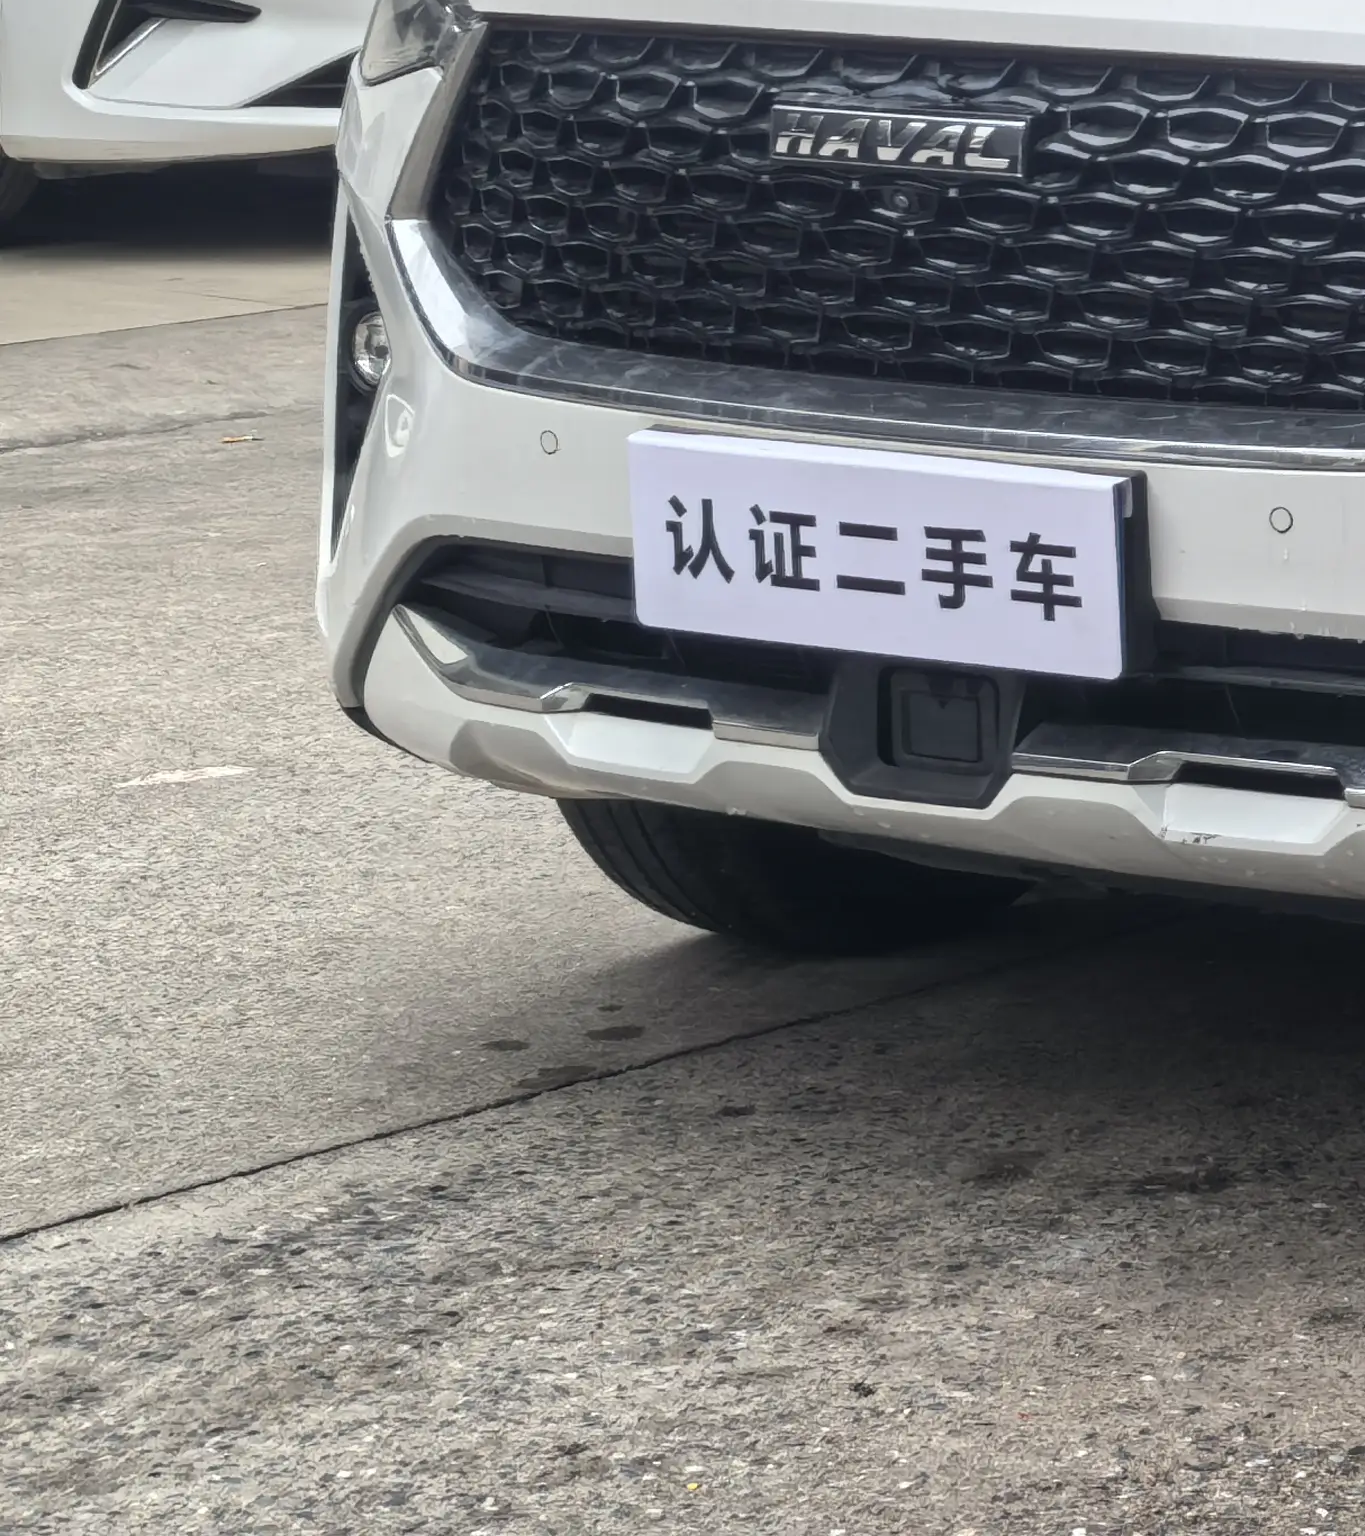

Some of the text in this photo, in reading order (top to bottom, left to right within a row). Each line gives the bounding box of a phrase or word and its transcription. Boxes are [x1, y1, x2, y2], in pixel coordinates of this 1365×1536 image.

[774, 111, 1011, 170] HAVAL
[665, 494, 1083, 622] 认证二手车
